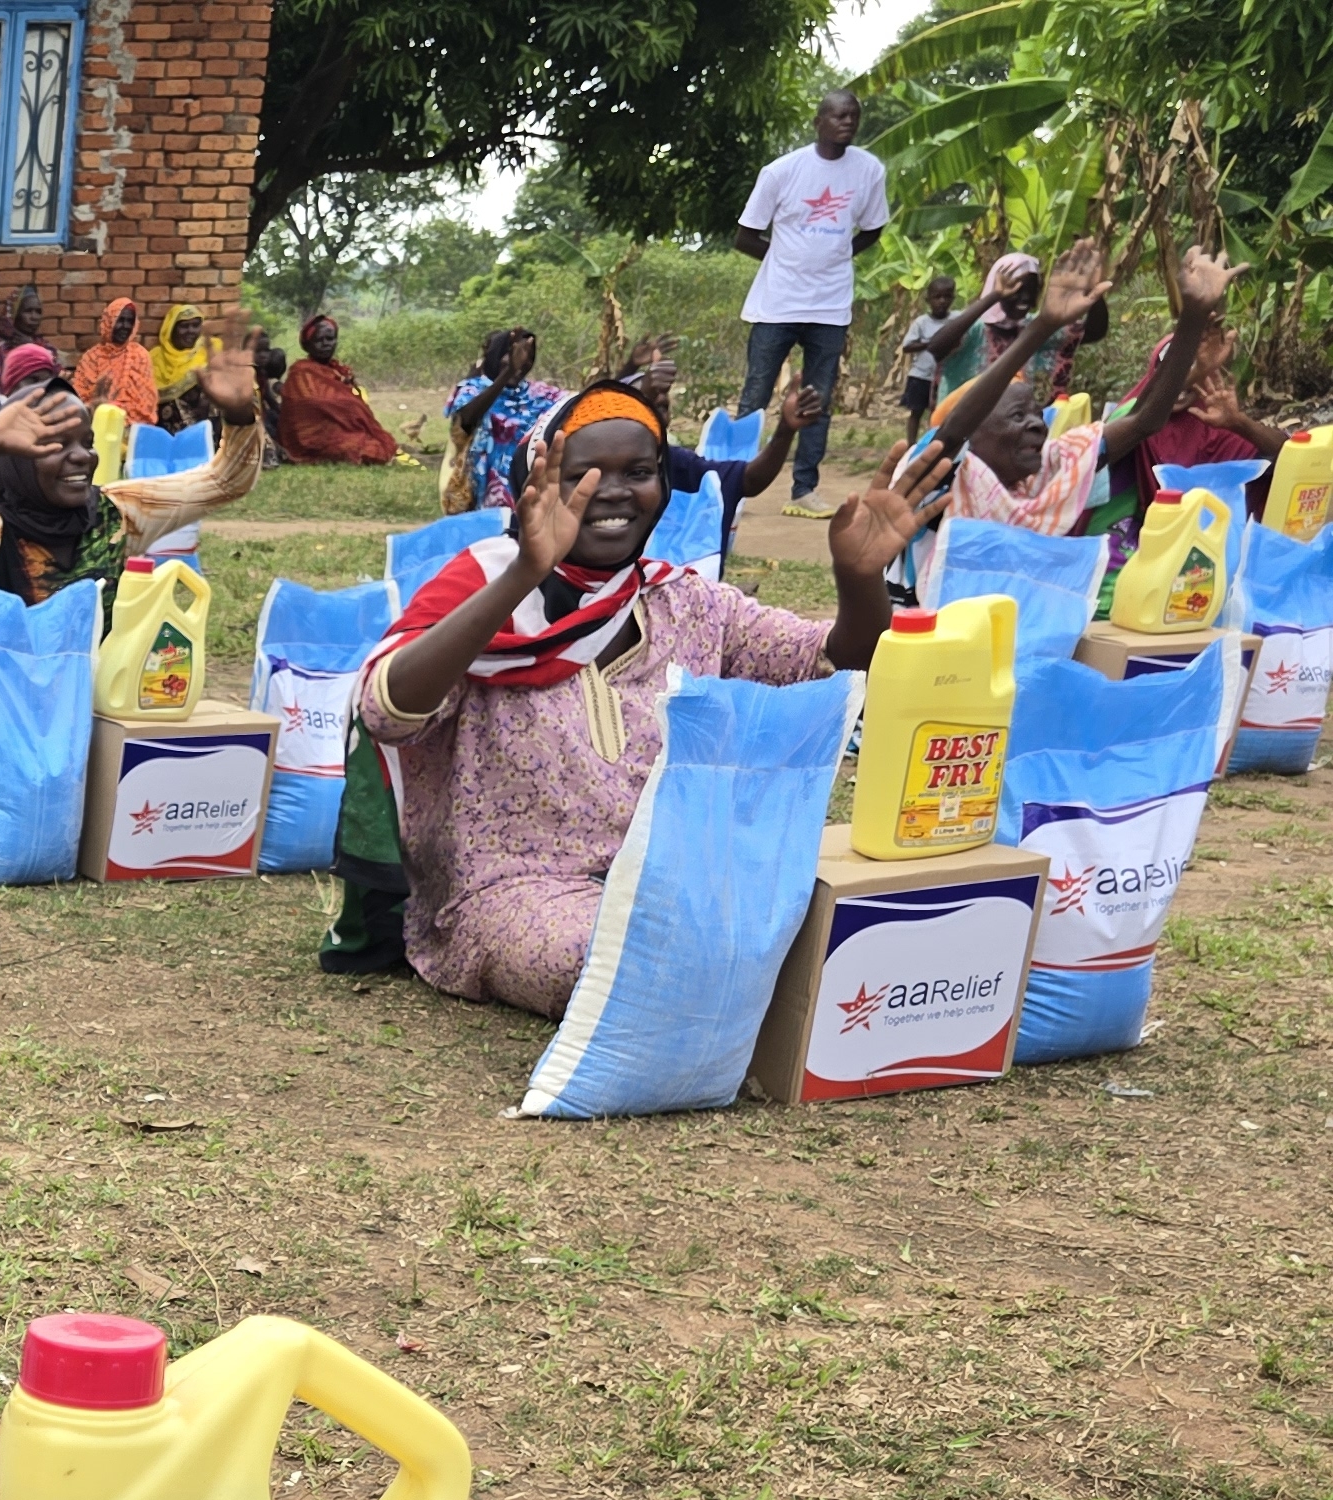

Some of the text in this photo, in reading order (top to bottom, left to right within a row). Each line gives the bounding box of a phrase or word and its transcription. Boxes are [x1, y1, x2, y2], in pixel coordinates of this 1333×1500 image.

[1297, 485, 1329, 501] BEST
[924, 732, 999, 761] BEST
[927, 760, 989, 788] FRY
[165, 798, 248, 820] aaRelief
[887, 971, 1004, 1009] aaRelief
[883, 1003, 996, 1027] Together we help others
